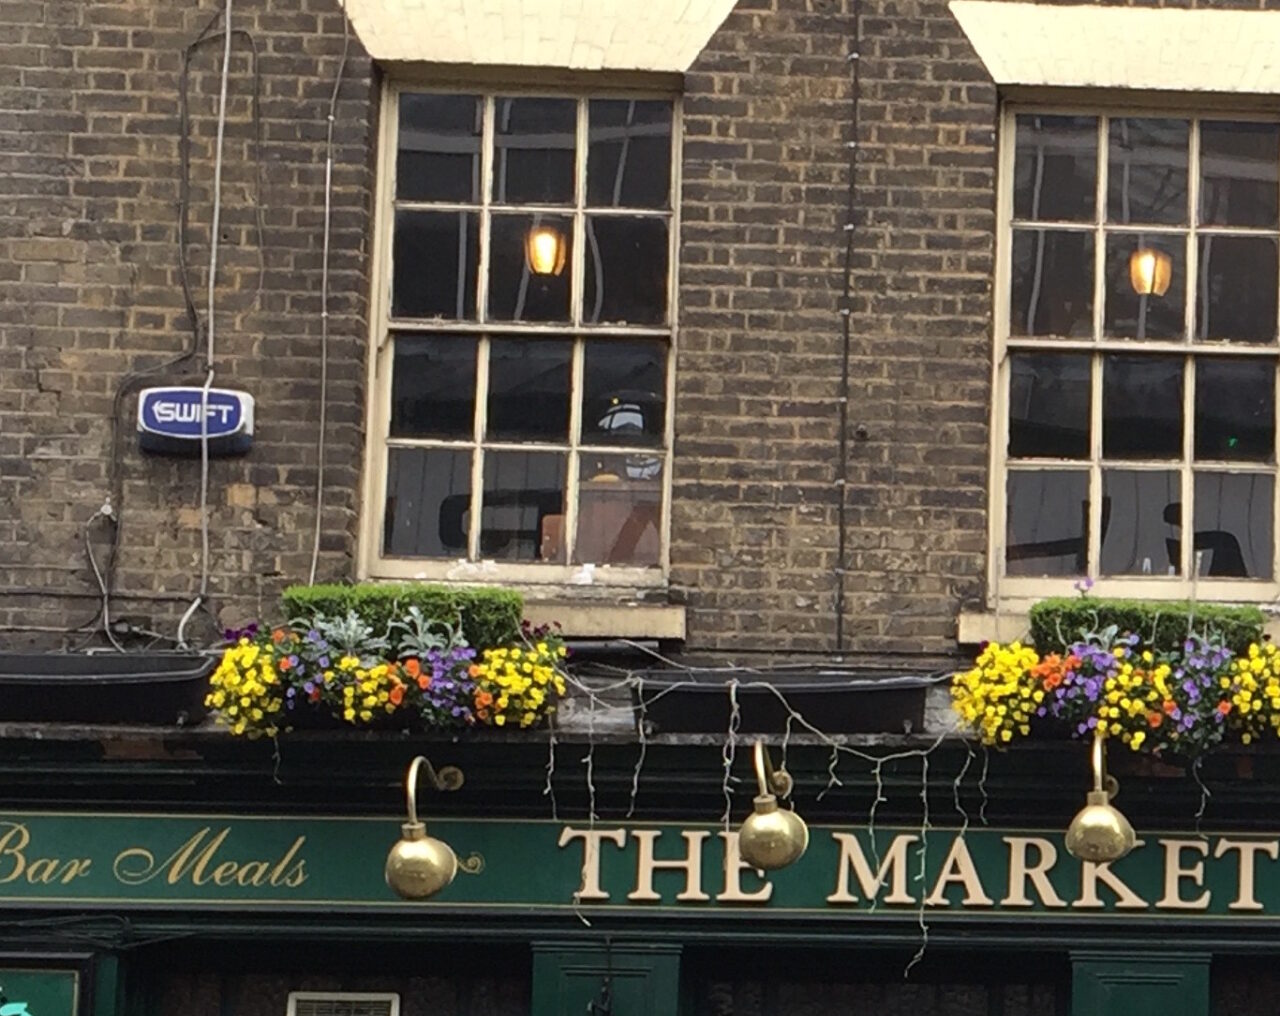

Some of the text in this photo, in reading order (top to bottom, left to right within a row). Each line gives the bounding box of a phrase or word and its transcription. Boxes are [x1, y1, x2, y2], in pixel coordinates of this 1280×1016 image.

[153, 401, 234, 424] SWIFT
[0, 821, 310, 888] Bar Meals
[558, 827, 774, 901] THE
[826, 832, 1279, 910] MARKET
